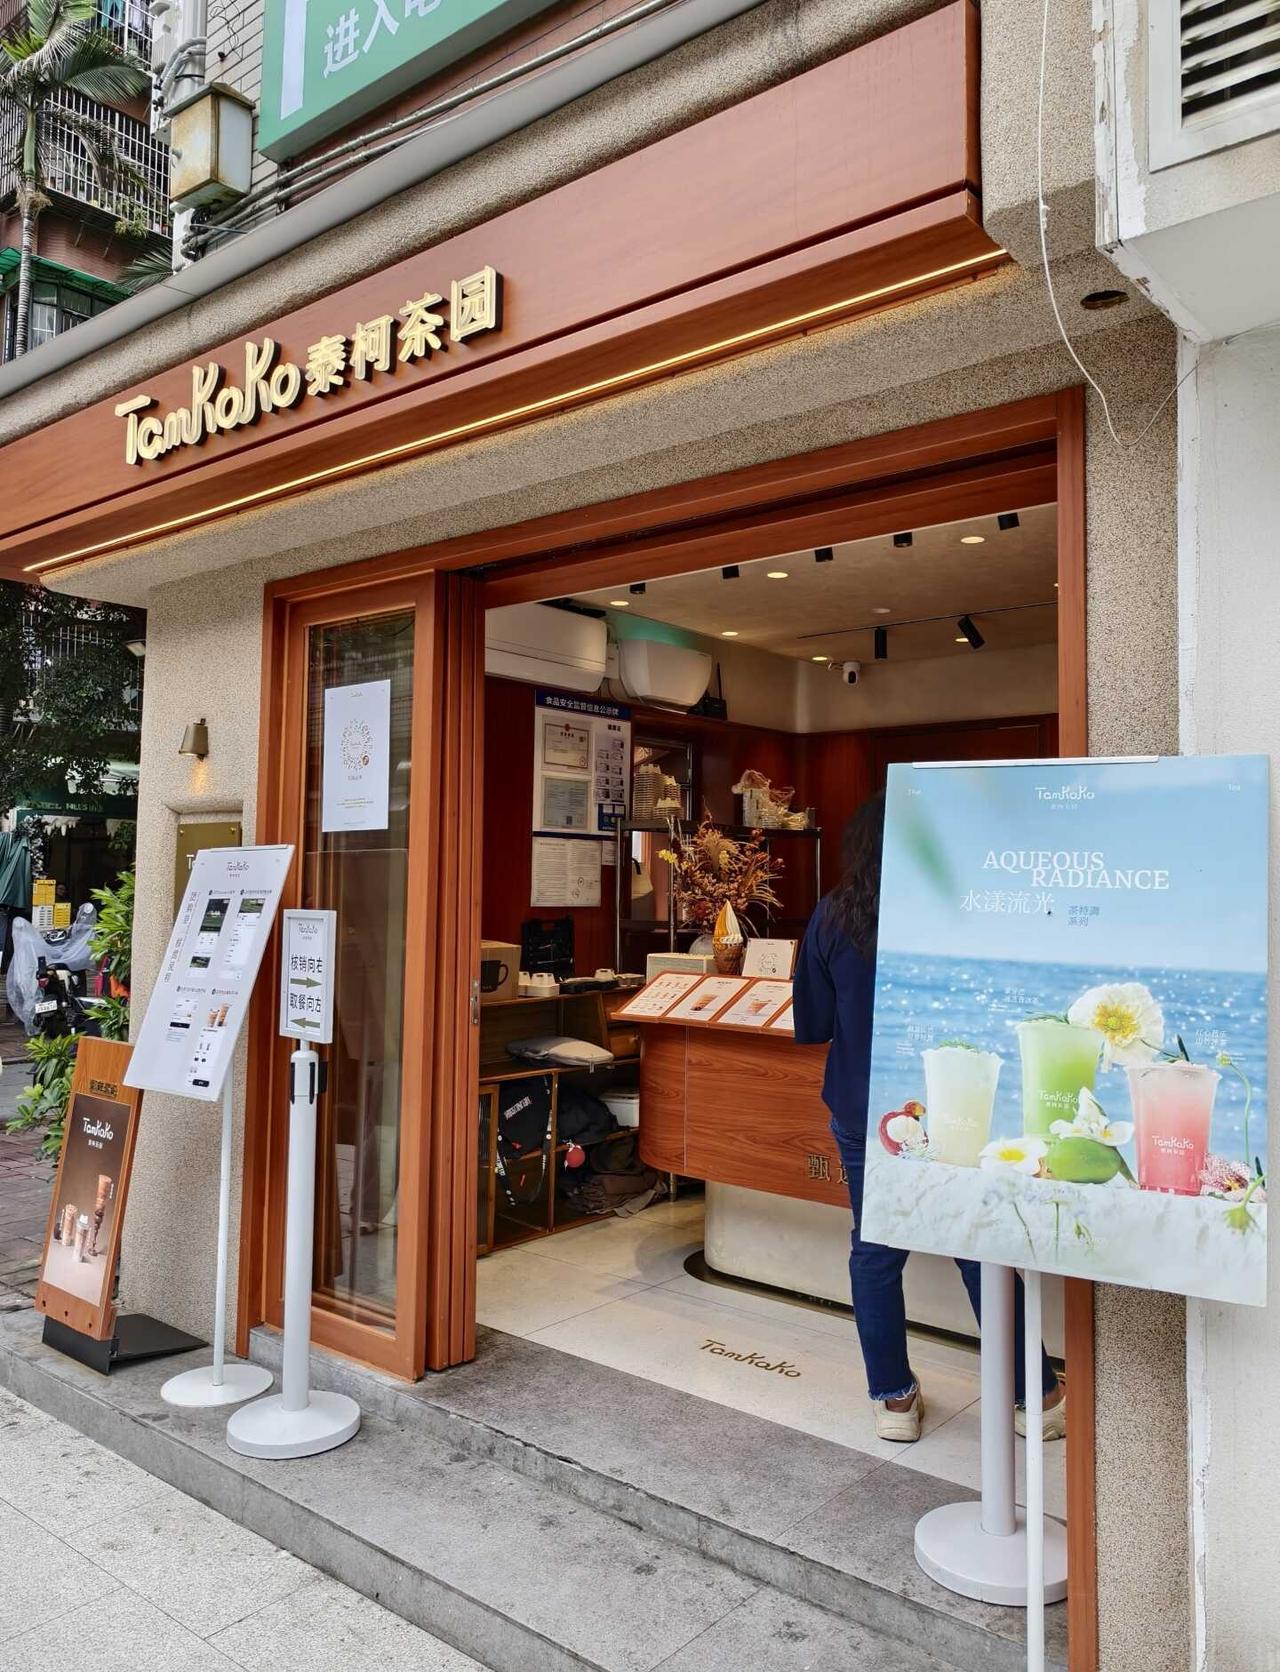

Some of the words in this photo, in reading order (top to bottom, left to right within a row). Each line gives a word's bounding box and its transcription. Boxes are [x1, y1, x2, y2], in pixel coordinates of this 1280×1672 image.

[306, 264, 499, 397] 泰柯茶园
[983, 850, 1104, 873] AQUEOUS
[1031, 869, 1170, 889] RADIANCE
[960, 889, 1055, 913] 水漾流光
